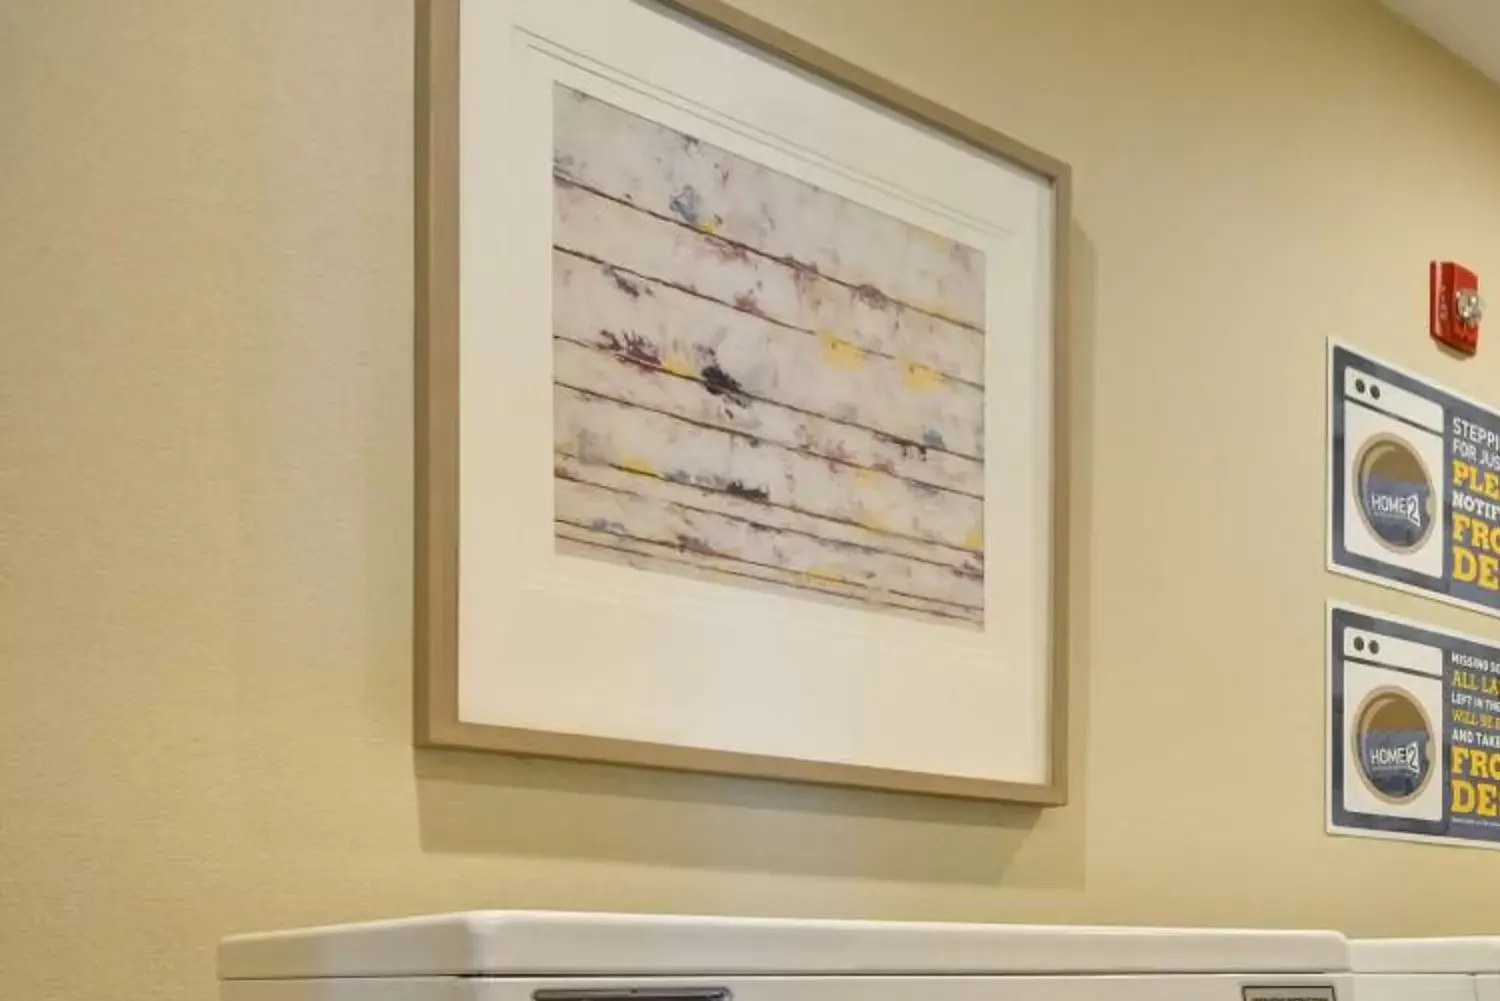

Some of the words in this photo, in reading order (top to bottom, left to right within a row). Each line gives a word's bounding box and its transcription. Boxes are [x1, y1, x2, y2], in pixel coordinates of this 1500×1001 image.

[1453, 438, 1477, 464] FOR
[1451, 651, 1489, 672] MISSING
[1452, 670, 1480, 691] ALL
[1451, 692, 1473, 707] LEFT
[1474, 697, 1483, 709] IN
[1485, 699, 1500, 713] THE
[1452, 708, 1479, 726] WILL
[1451, 727, 1474, 745] AND
